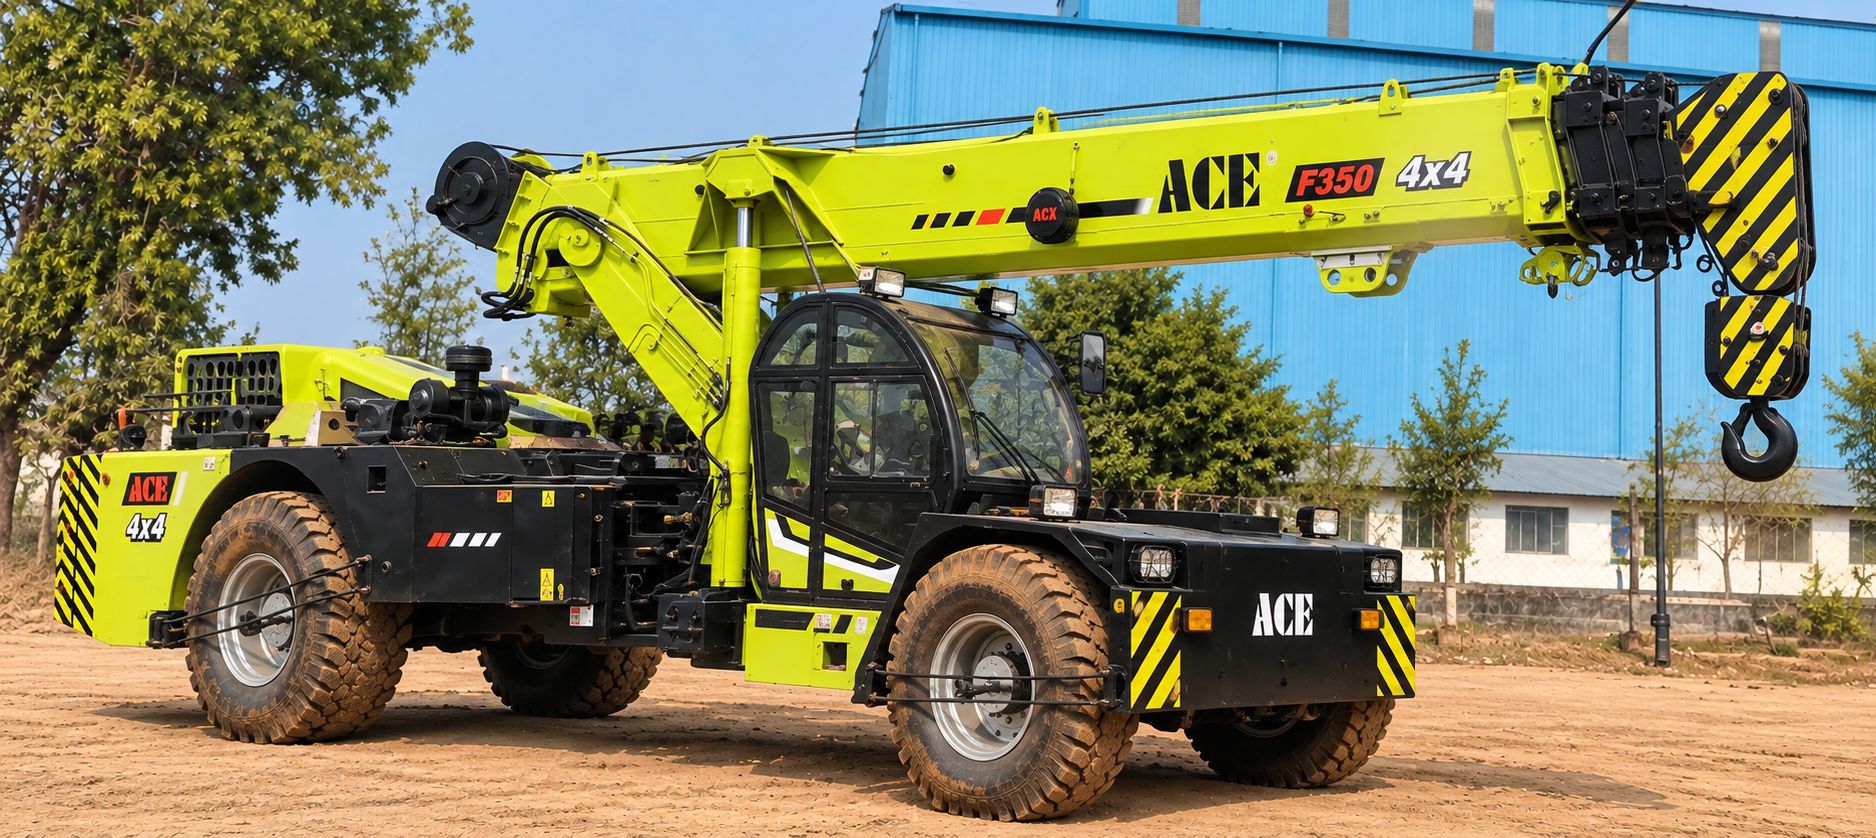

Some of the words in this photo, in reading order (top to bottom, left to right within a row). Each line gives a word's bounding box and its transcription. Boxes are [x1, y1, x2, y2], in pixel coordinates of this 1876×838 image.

[1157, 152, 1261, 214] ACE
[1295, 163, 1375, 197] F350
[1396, 152, 1470, 189] 4x4
[1032, 206, 1058, 222] ACX
[128, 475, 169, 502] ACE
[125, 512, 167, 541] 4x4
[1251, 592, 1314, 637] ACE
